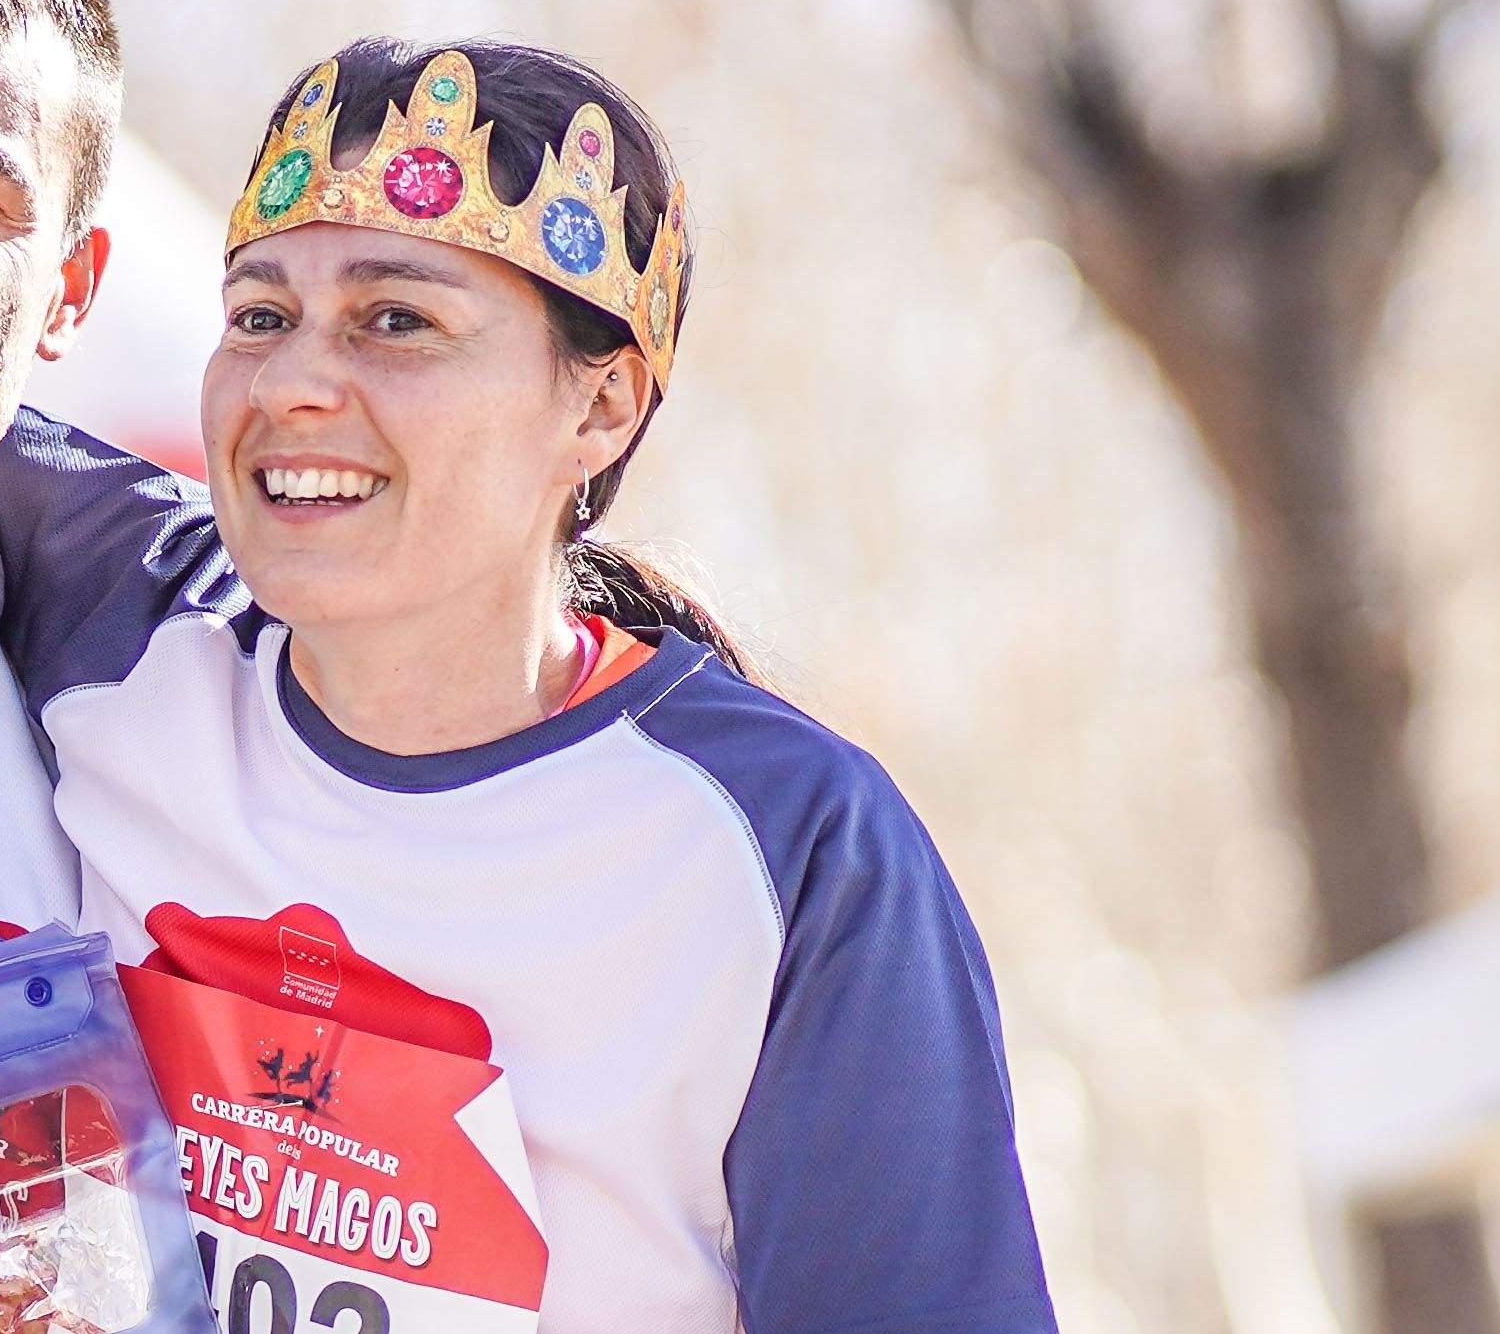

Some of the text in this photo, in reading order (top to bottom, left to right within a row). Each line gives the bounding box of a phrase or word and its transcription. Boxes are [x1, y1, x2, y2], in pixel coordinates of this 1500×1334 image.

[280, 985, 334, 1009] de Madrid
[283, 976, 338, 999] Comunidad
[191, 1093, 297, 1137] CARRERA
[176, 1125, 438, 1267] EYES MAGOS
